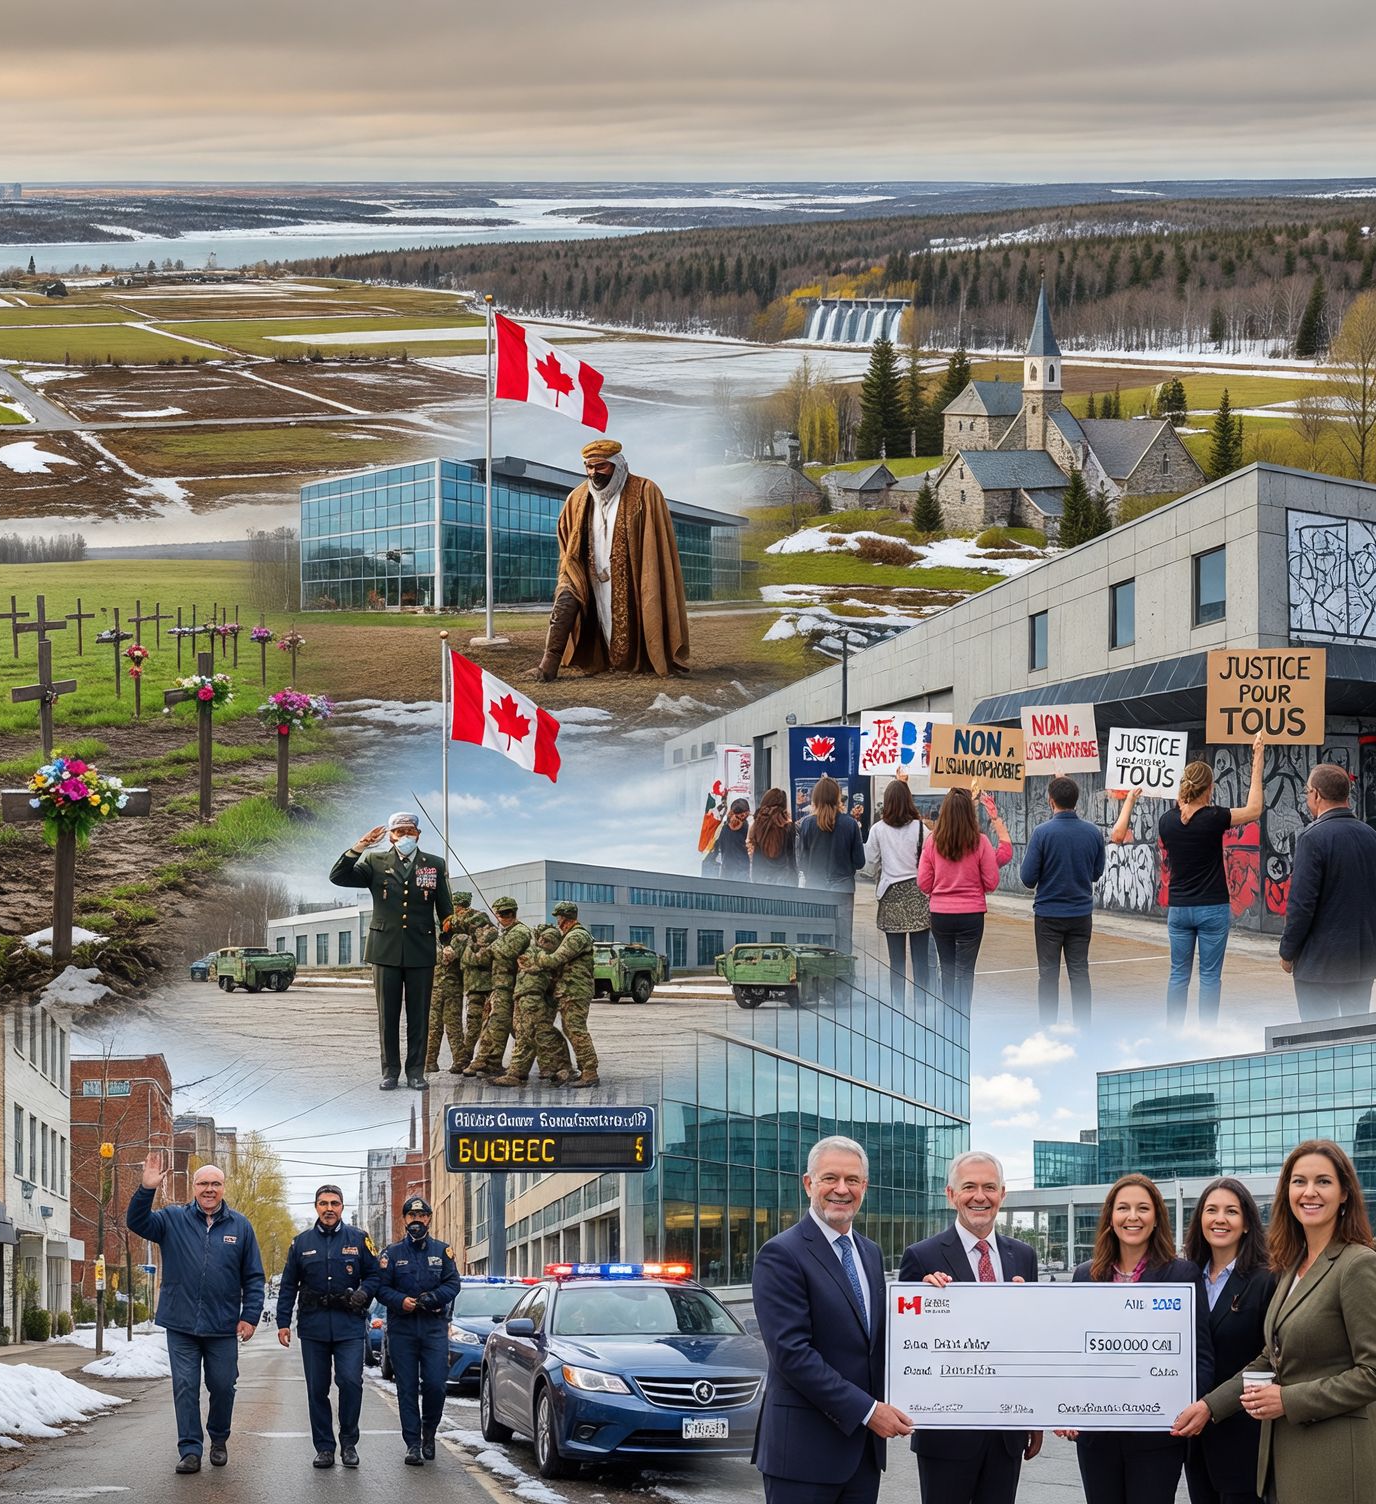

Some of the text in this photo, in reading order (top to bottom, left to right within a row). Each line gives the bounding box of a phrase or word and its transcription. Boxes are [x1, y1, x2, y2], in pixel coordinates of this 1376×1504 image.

[1219, 656, 1311, 680] JUSTICE
[1239, 684, 1291, 703] POUR
[1032, 714, 1069, 736] NON
[1219, 707, 1306, 736] TOUS
[953, 728, 1002, 757] NON
[1114, 733, 1181, 756] JUSTICE
[1116, 764, 1175, 788] TOUS
[1089, 1338, 1149, 1352] $500,000
